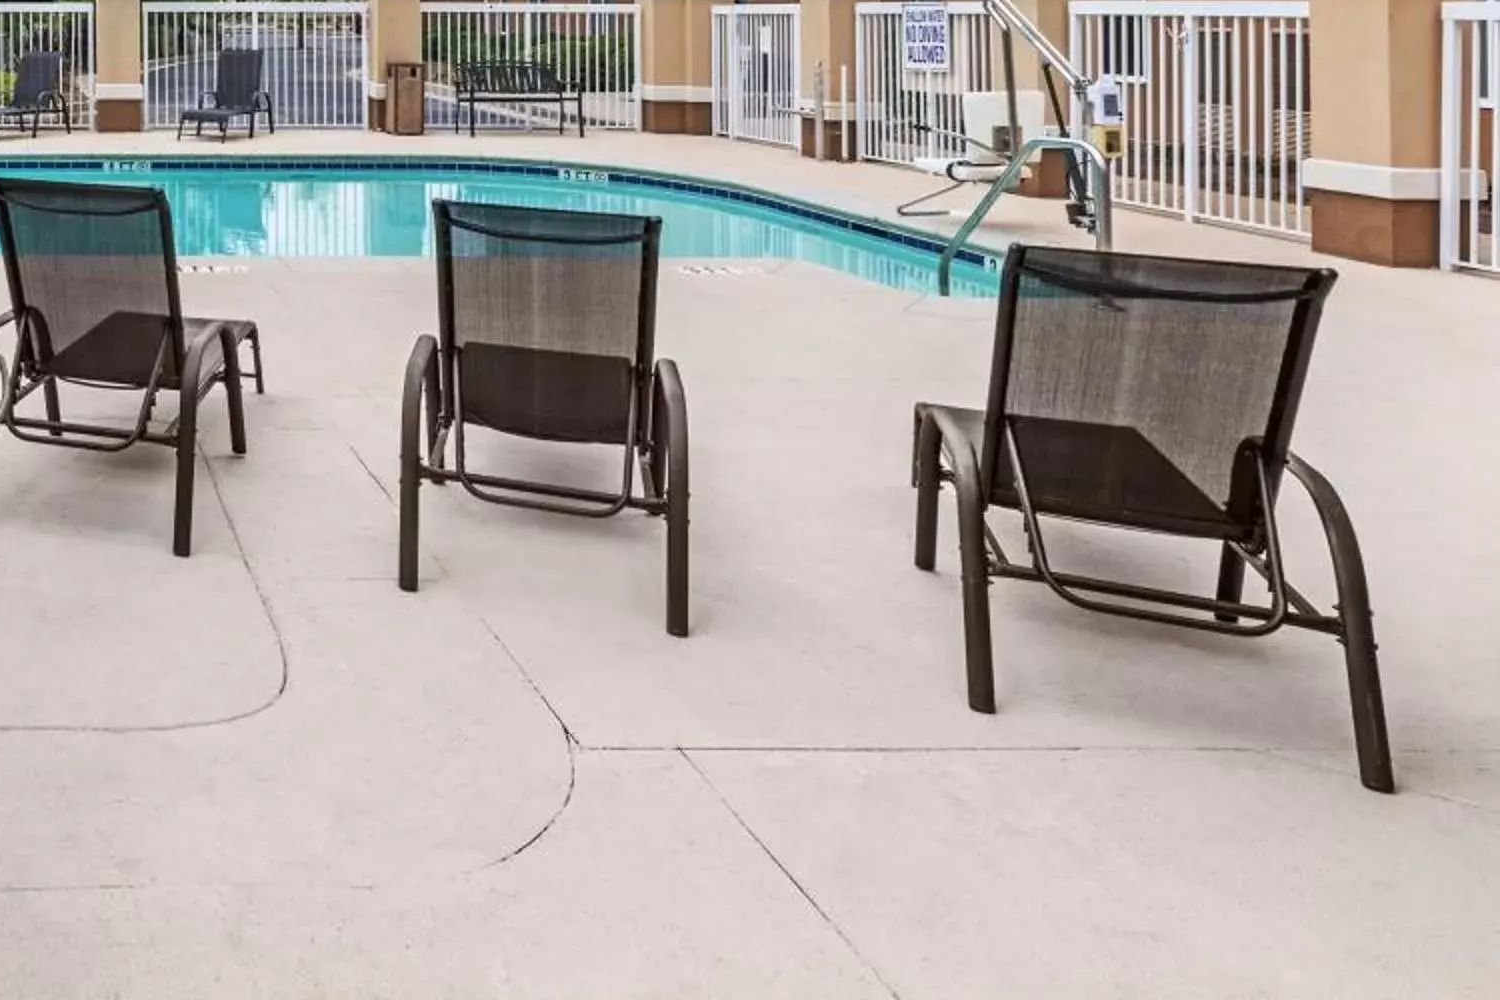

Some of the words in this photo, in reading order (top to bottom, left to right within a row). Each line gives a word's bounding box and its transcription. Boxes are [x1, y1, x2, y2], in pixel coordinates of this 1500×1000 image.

[906, 24, 917, 43] NO
[919, 24, 945, 43] DIVING
[907, 46, 945, 64] ALLOWED
